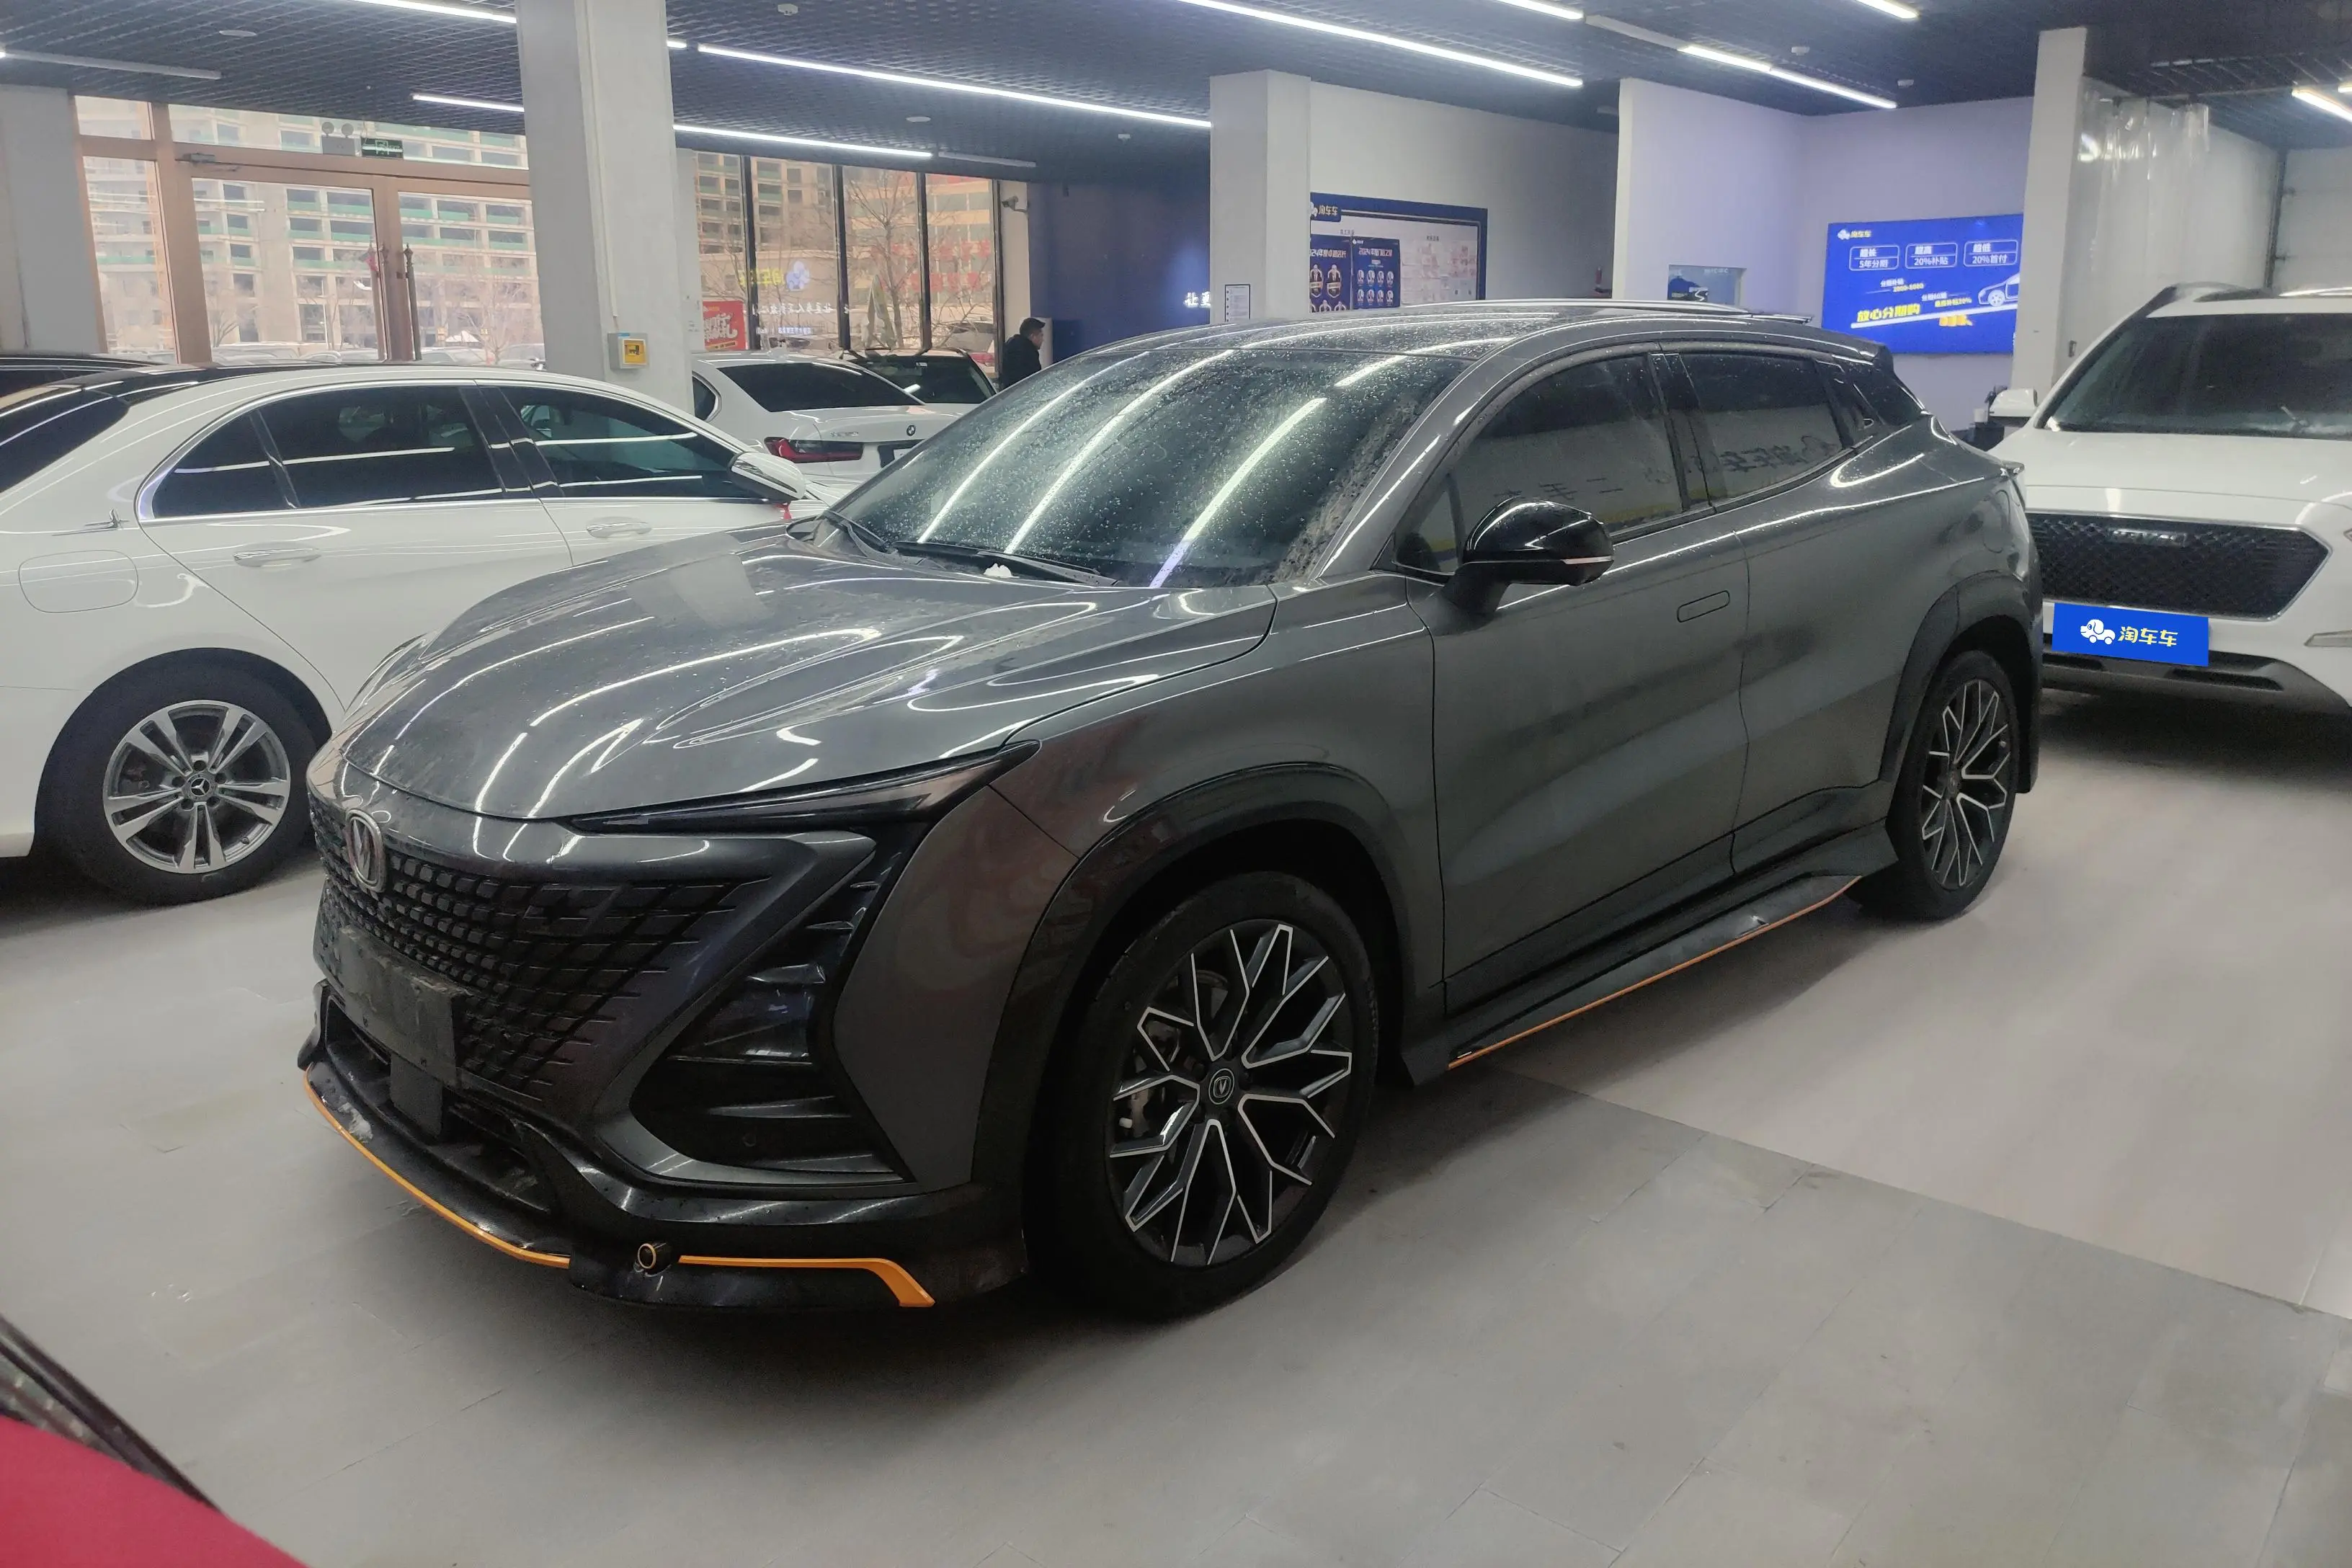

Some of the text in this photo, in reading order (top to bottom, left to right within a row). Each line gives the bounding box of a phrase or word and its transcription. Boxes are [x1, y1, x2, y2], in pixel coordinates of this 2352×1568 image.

[1318, 205, 1338, 216] 淘车车
[1973, 243, 1991, 253] 超低
[1858, 259, 1889, 269] 5年分期
[1914, 257, 1948, 266] 20%补贴
[1972, 254, 2008, 264] 20%首付
